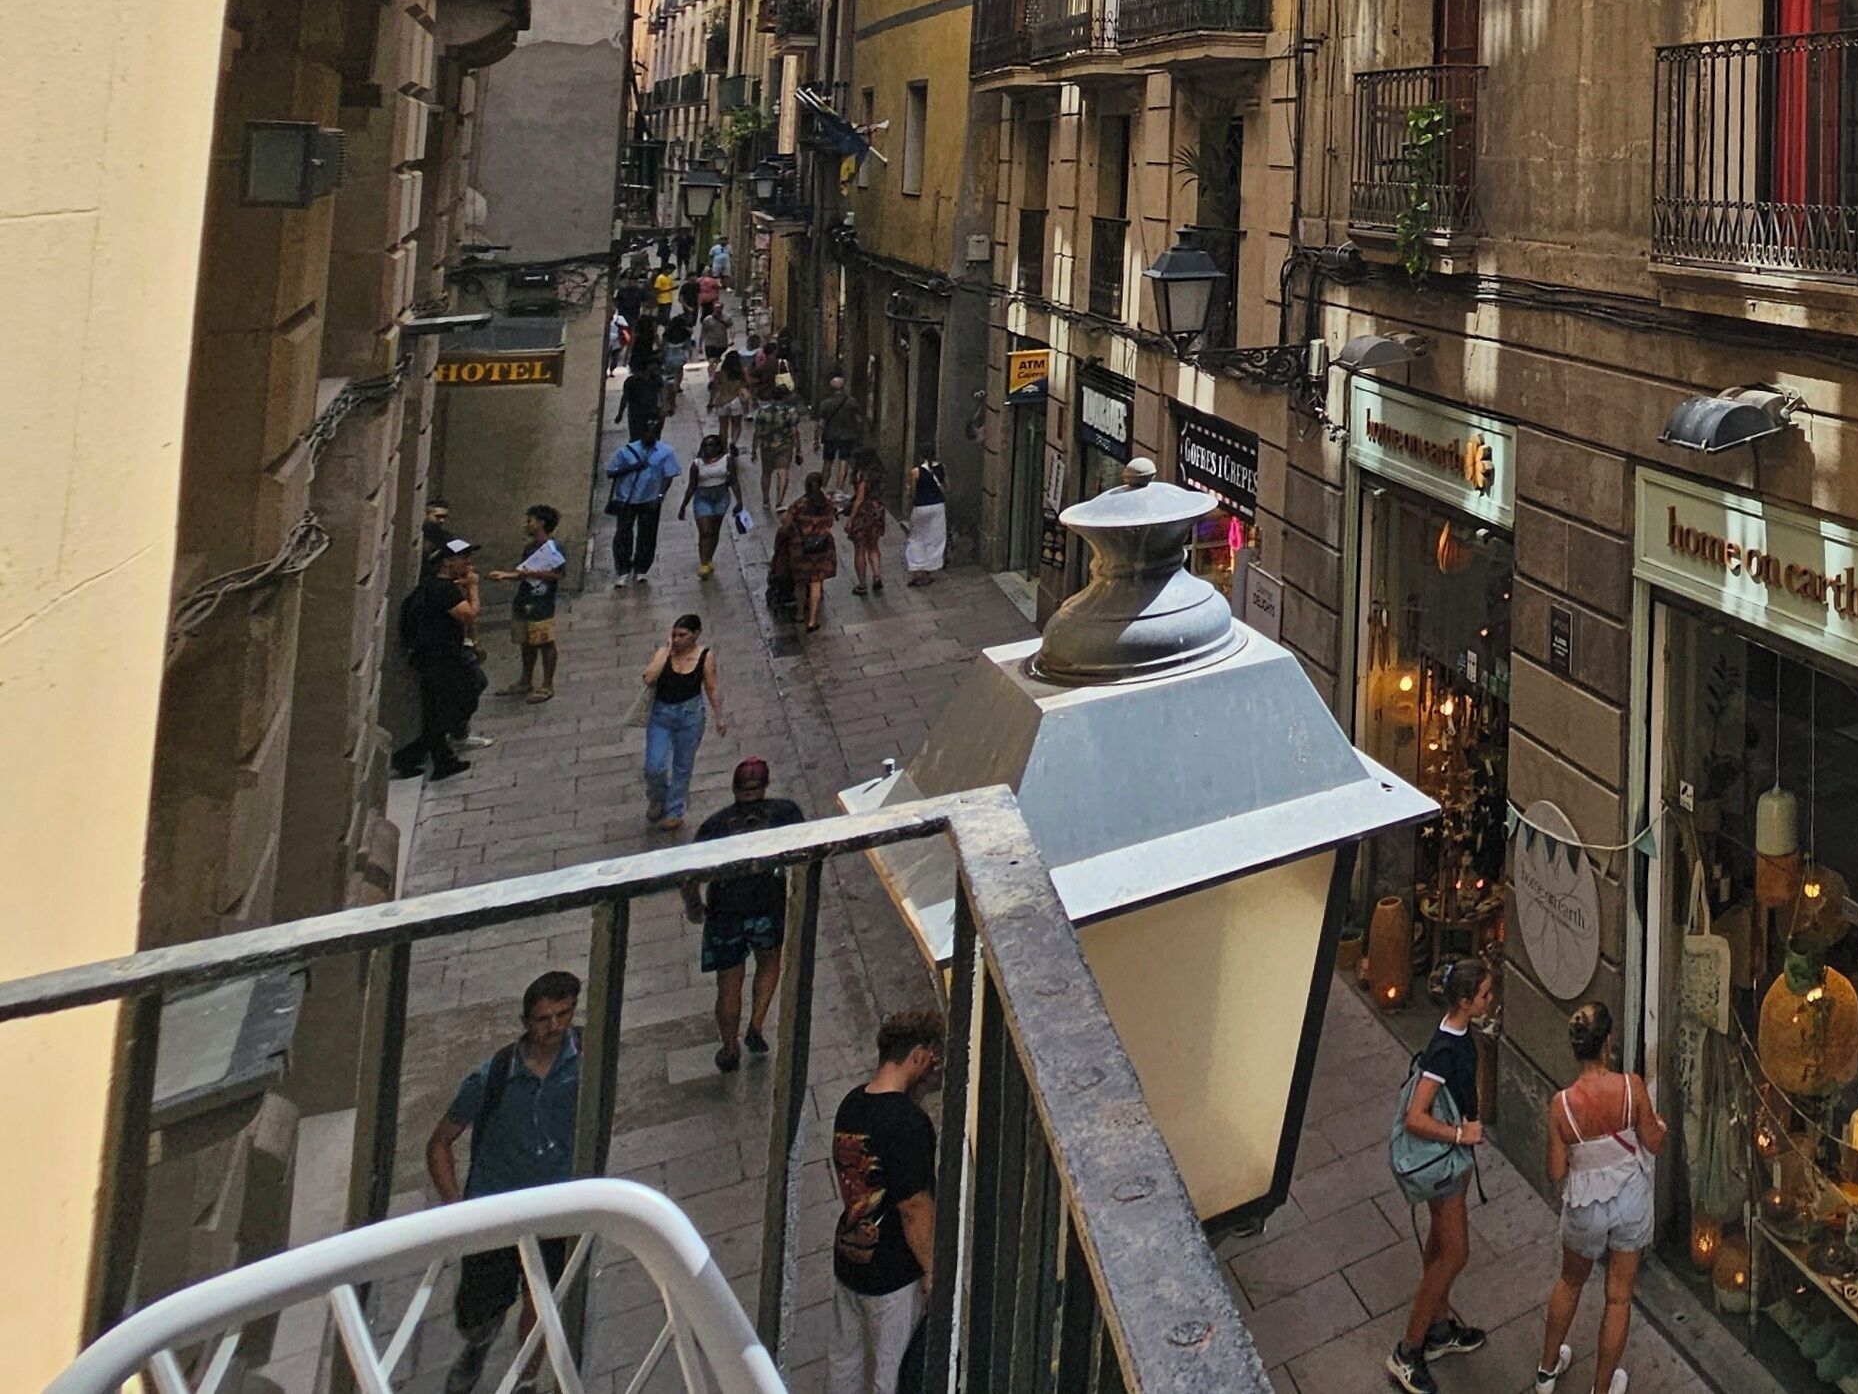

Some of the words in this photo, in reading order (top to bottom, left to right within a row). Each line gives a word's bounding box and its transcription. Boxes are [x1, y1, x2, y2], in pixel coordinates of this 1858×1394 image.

[436, 361, 551, 382] HOTEL
[1019, 360, 1045, 370] ATM
[1184, 437, 1217, 475] GOFRES
[1223, 454, 1258, 496] CREPES
[1667, 506, 1741, 571] home
[1746, 549, 1783, 588] on
